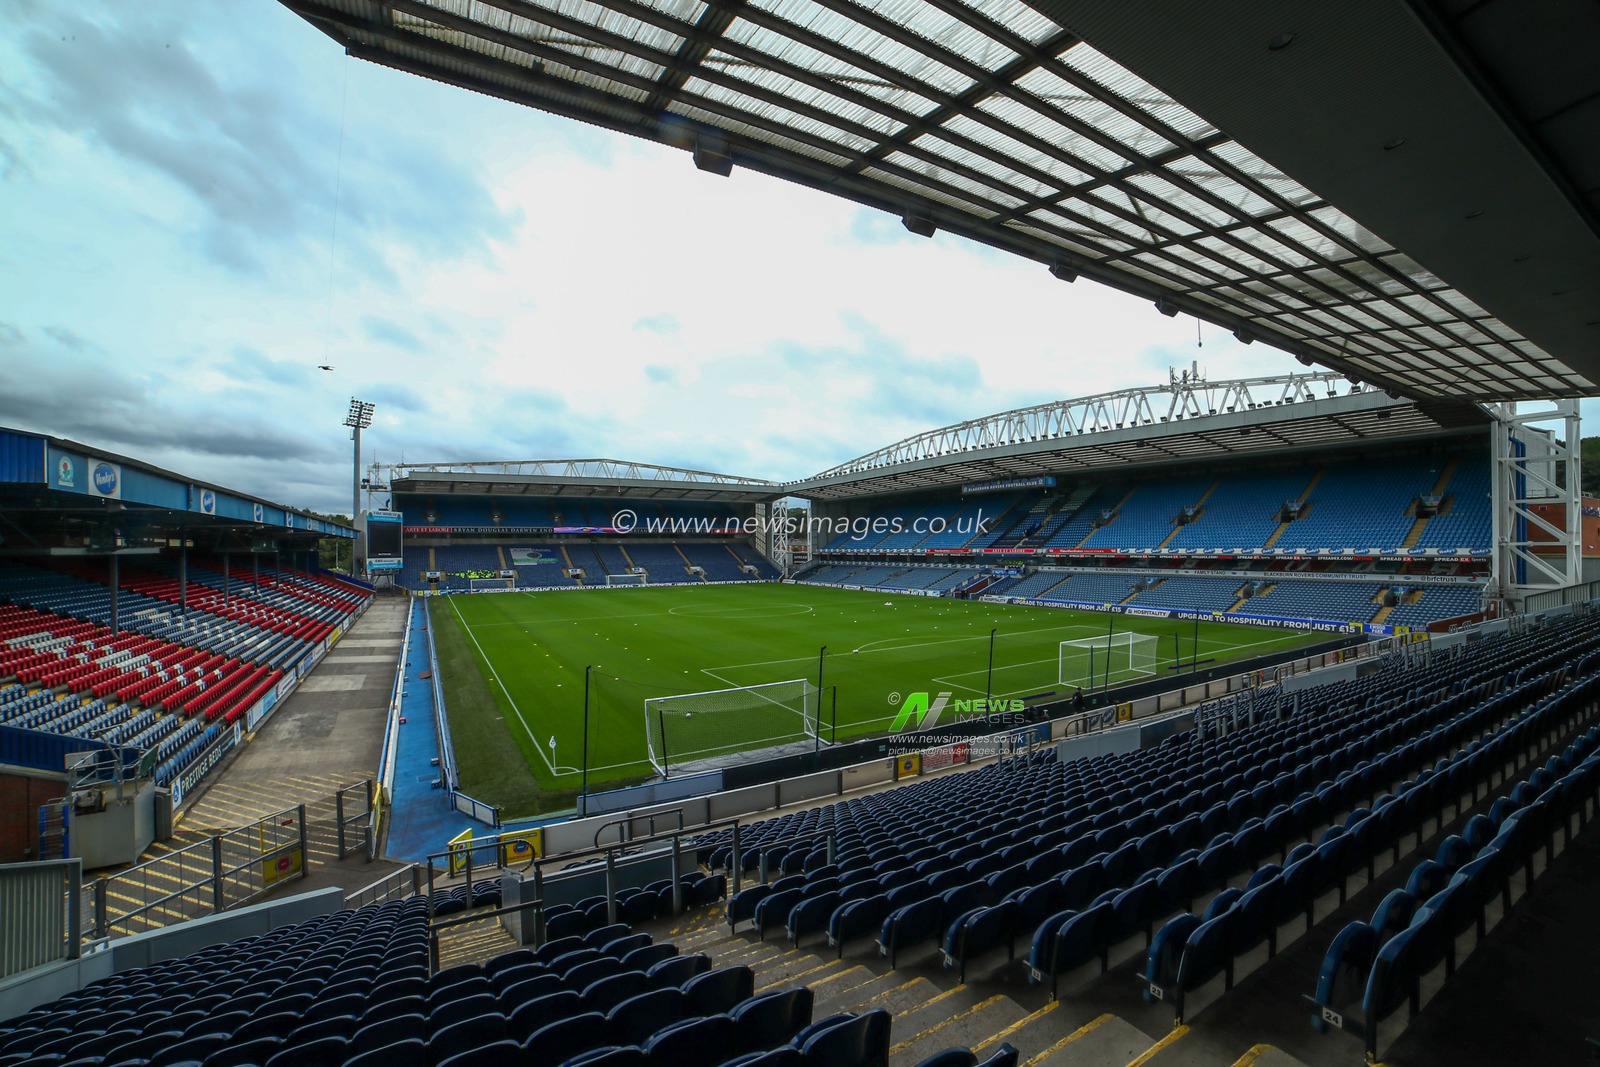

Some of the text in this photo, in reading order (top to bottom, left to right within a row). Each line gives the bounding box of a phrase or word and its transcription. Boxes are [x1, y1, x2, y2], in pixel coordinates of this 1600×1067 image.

[1178, 612, 1213, 621] UPGRADE
[1227, 616, 1281, 627] HOSPITALITY
[1284, 620, 1310, 629] FROM
[181, 745, 222, 795] PRESTIGE BEDS
[1152, 987, 1162, 996] 23
[1325, 1012, 1339, 1023] 24
